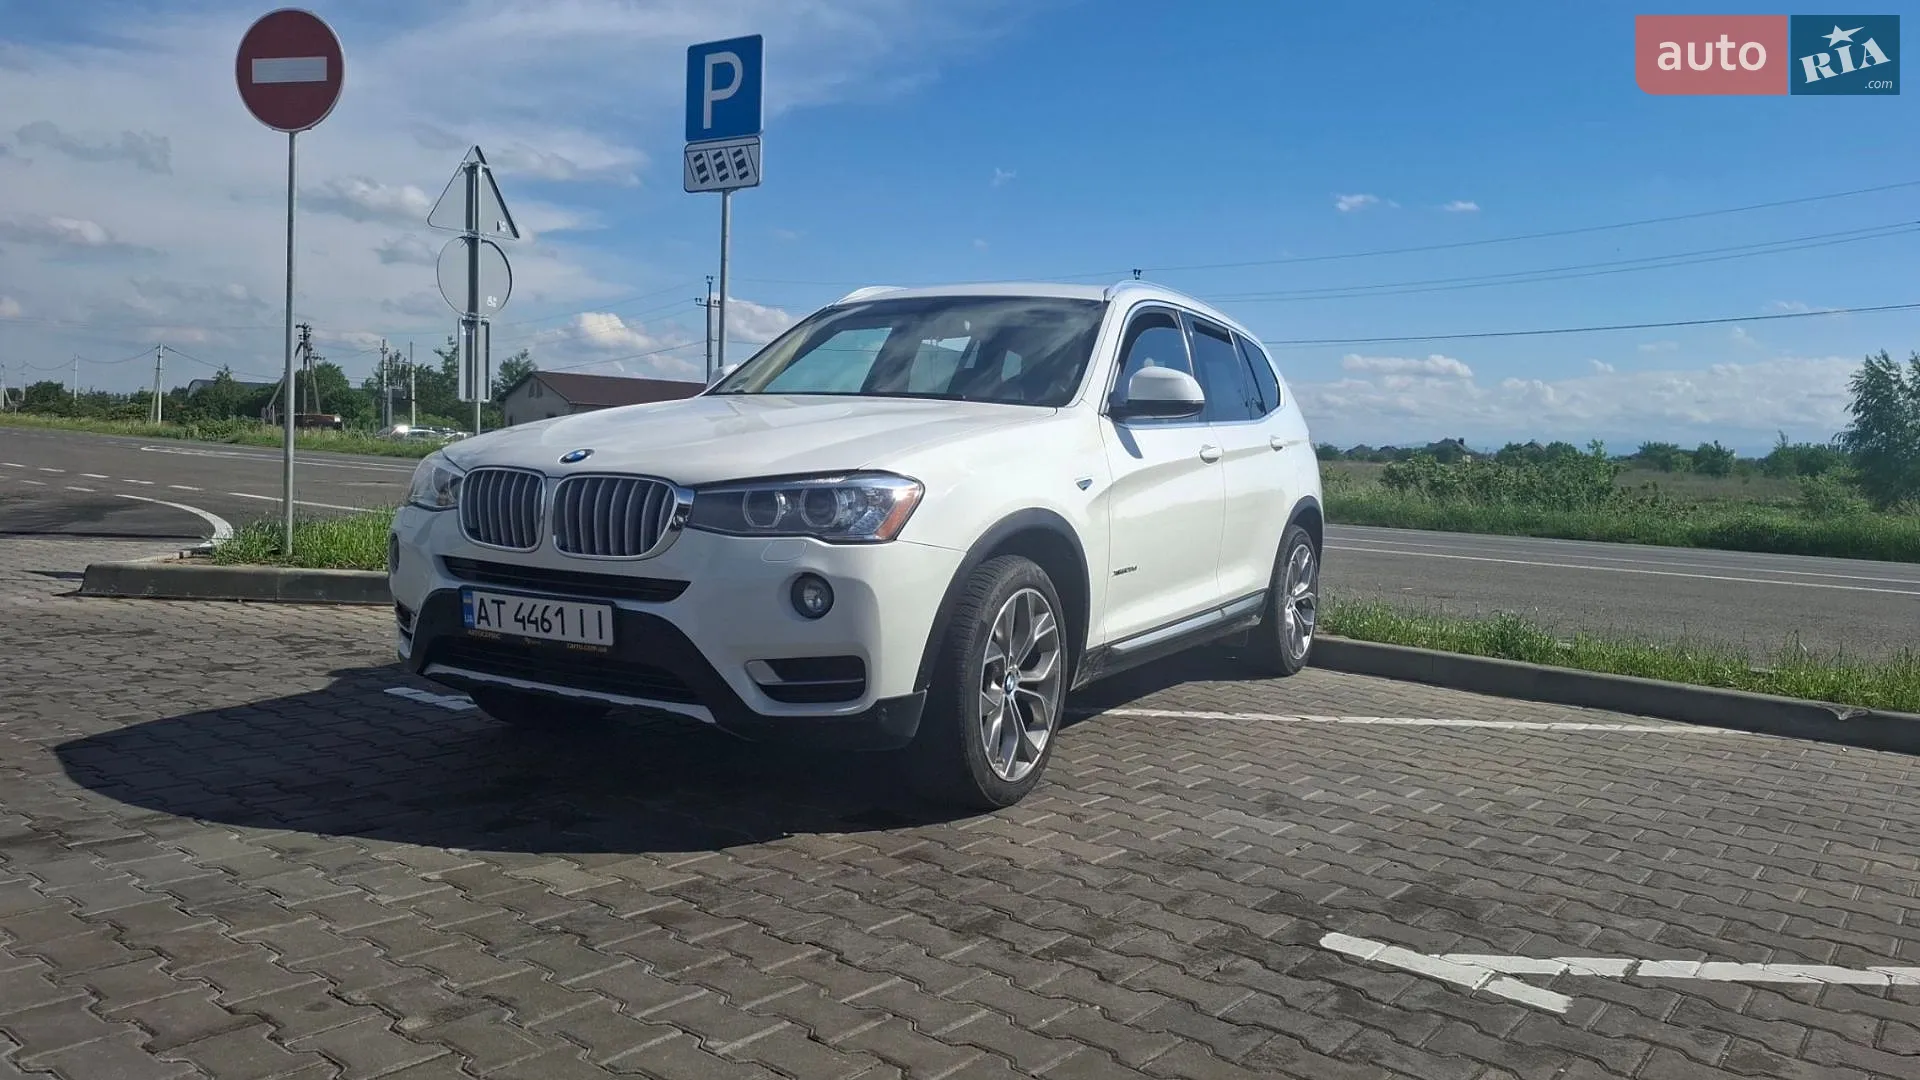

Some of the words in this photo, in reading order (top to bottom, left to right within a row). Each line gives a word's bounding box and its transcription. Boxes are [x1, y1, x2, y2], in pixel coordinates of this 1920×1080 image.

[703, 51, 743, 130] P
[476, 597, 506, 629] AT
[513, 602, 566, 636] 4461
